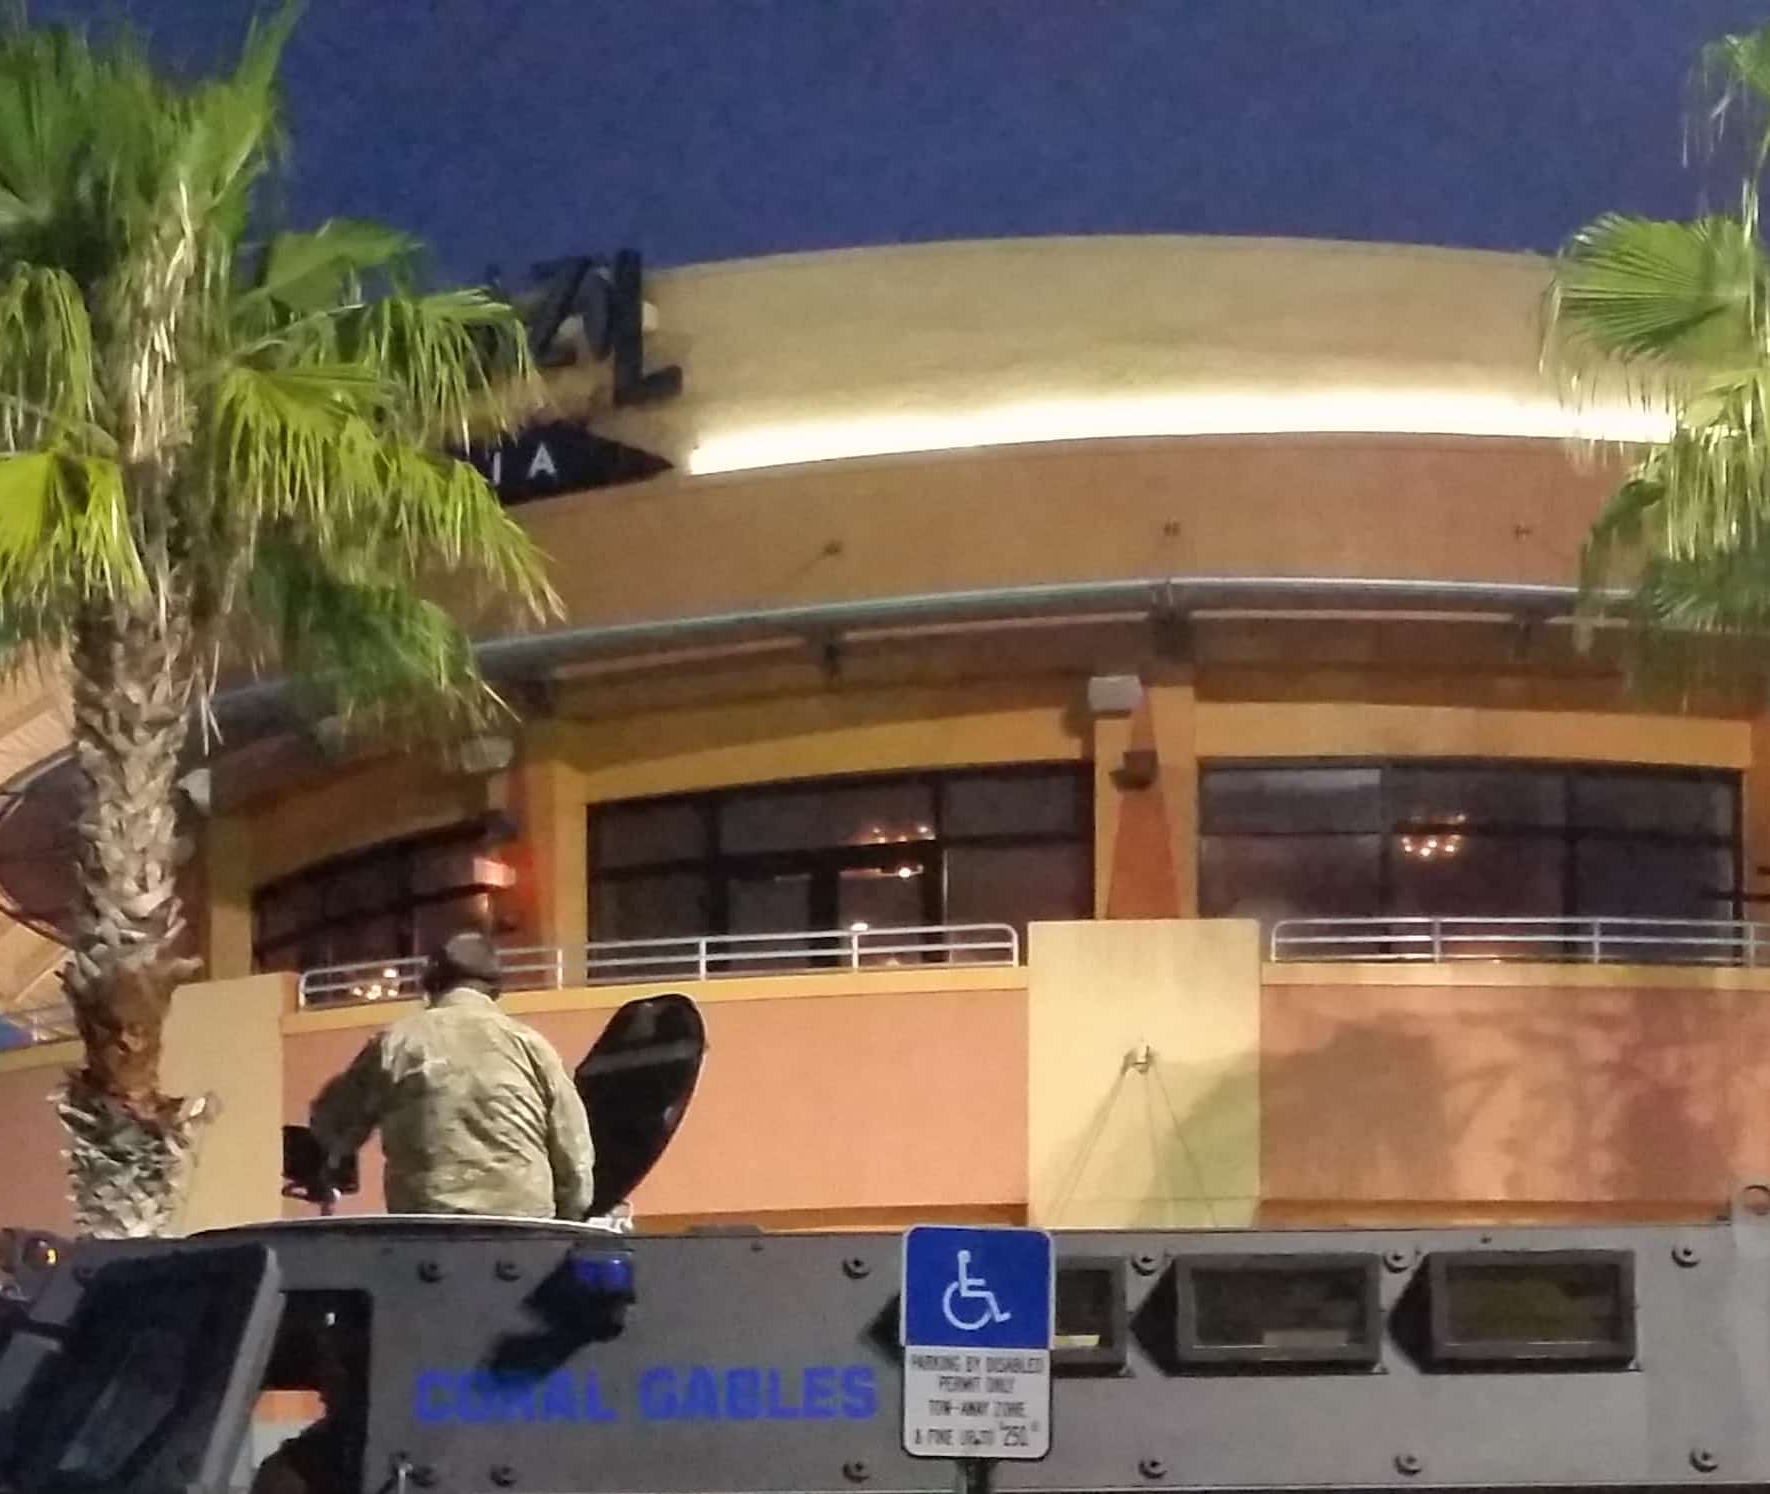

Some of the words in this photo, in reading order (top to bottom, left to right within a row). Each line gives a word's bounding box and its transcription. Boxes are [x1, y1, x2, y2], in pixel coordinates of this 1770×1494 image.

[912, 1355, 960, 1372] PARKING
[965, 1356, 980, 1373] BY
[986, 1357, 1044, 1373] DISABLED
[939, 1375, 981, 1392] PERMIT
[415, 1369, 619, 1423] CORAL
[639, 1365, 877, 1420] GABLES
